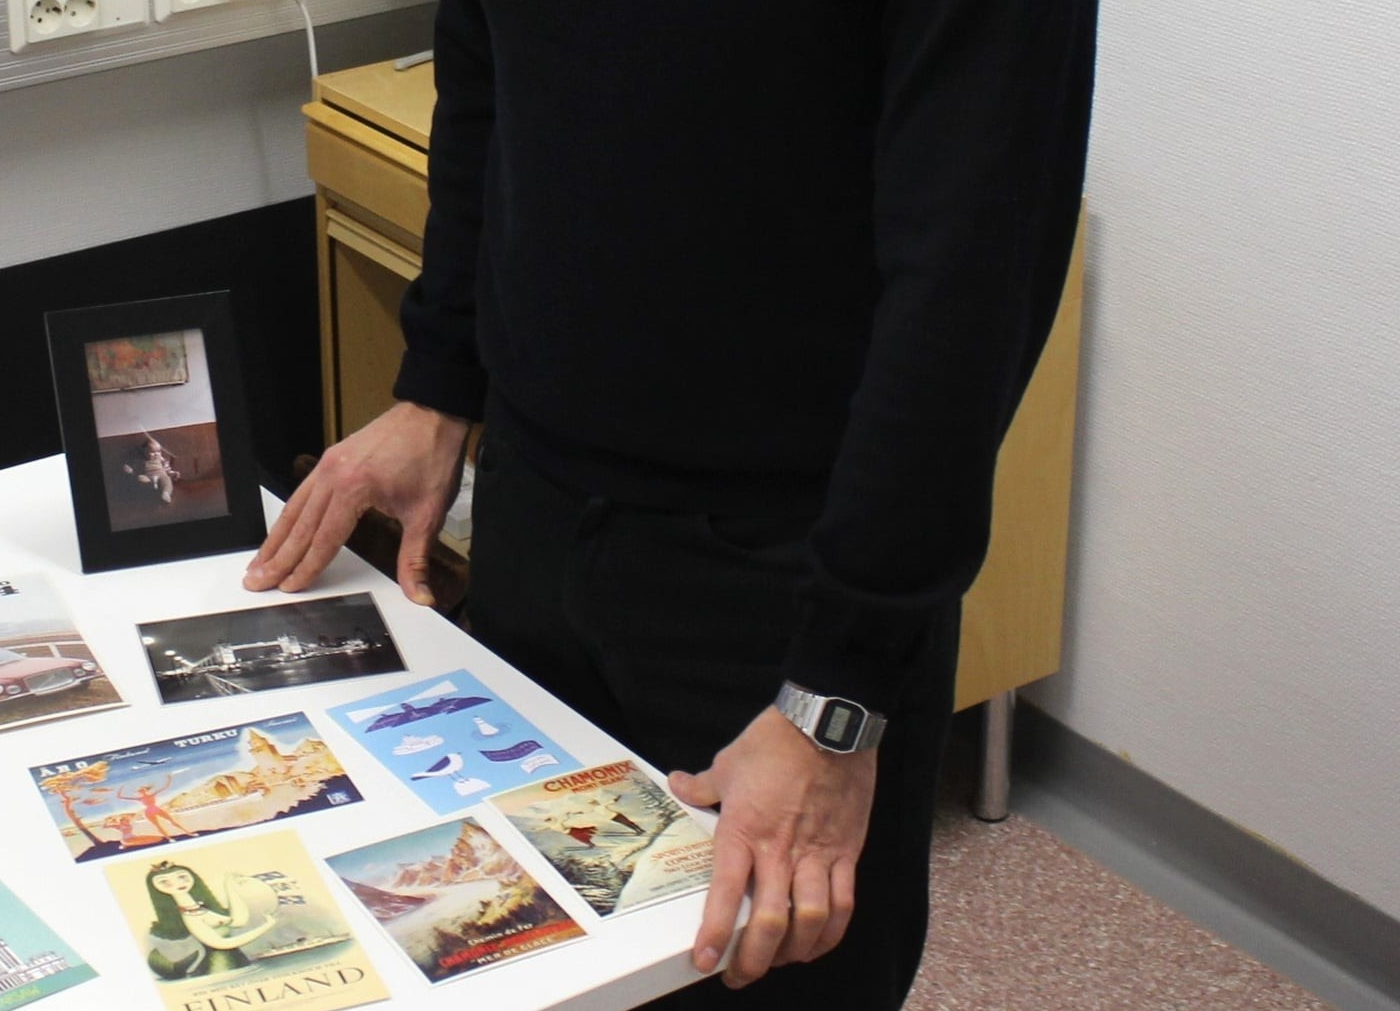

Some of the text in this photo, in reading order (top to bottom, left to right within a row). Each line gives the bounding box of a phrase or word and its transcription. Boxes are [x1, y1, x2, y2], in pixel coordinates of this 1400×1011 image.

[174, 729, 239, 748] TURKU
[544, 761, 638, 792] CHAMONIX
[183, 967, 366, 1011] FINLAND
